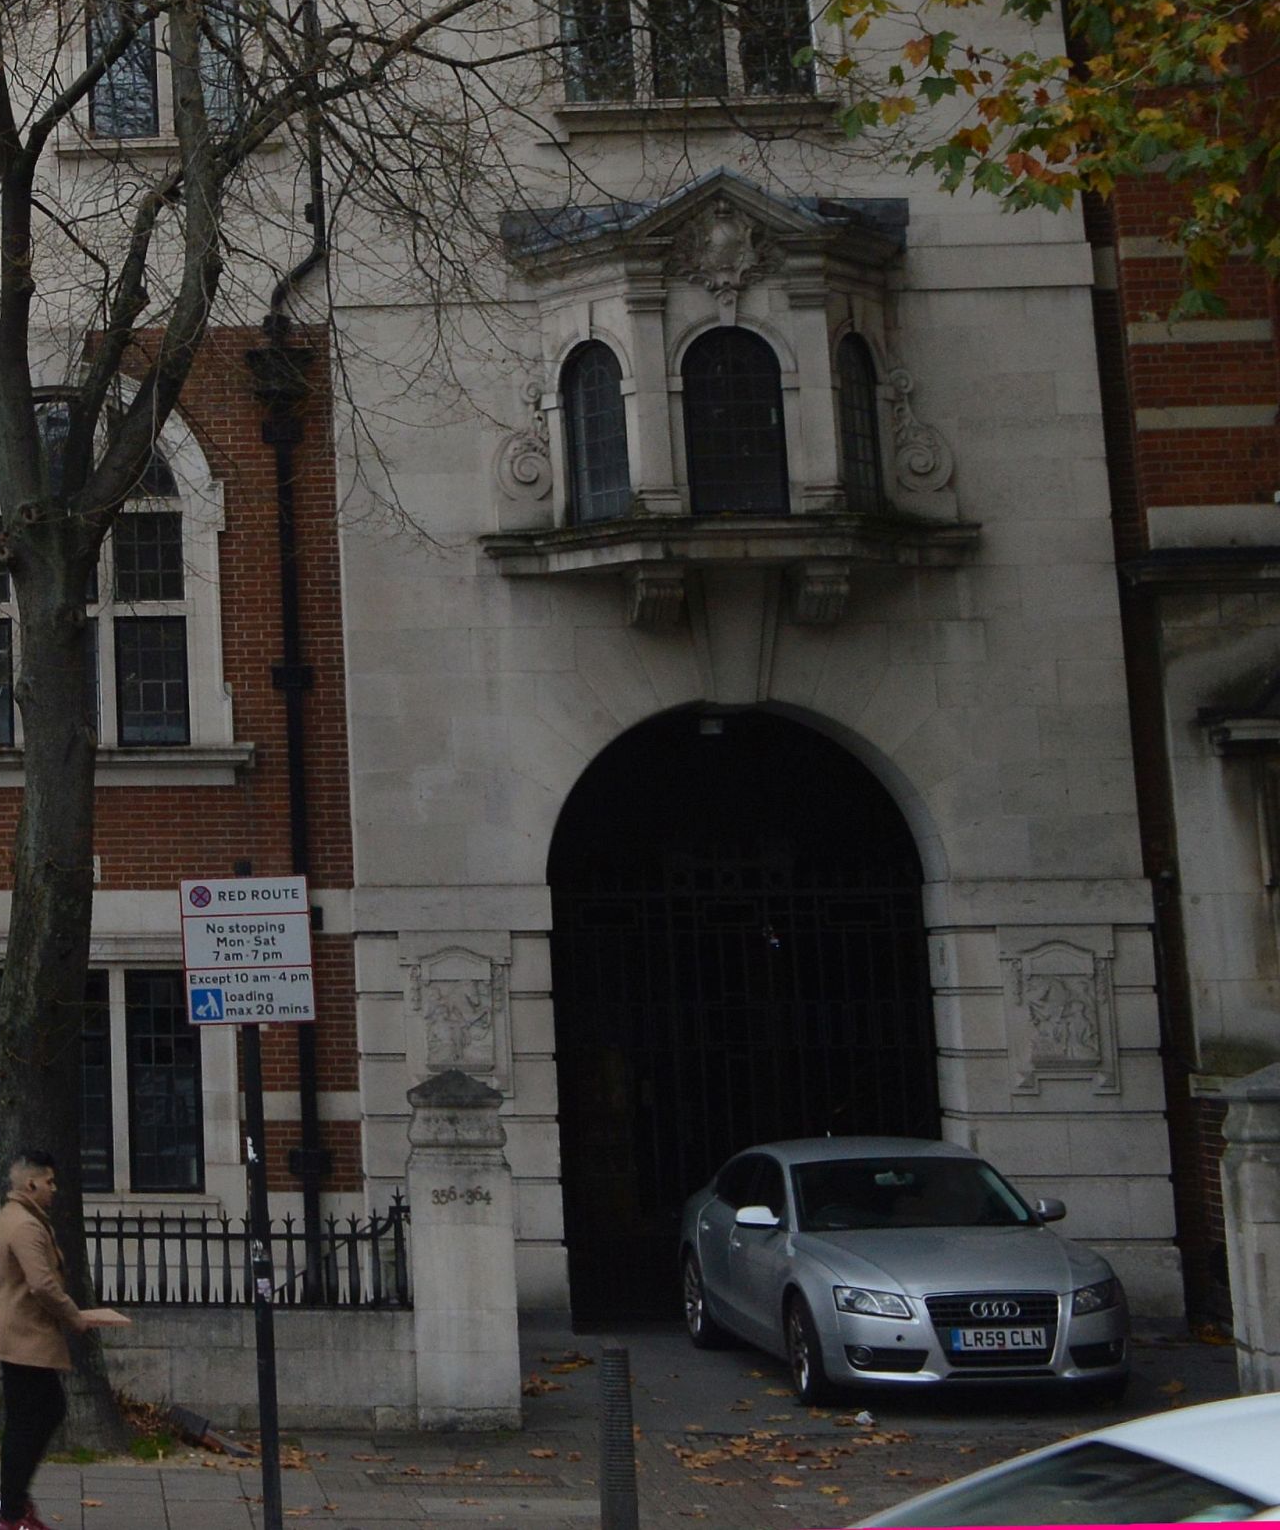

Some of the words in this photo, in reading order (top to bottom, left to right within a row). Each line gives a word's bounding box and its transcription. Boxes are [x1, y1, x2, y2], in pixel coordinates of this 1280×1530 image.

[218, 890, 246, 901] RED
[251, 888, 299, 900] ROUTE
[206, 923, 224, 934] No
[228, 921, 285, 935] stopping
[216, 937, 244, 947] Mon
[254, 935, 277, 946] Sat
[262, 950, 283, 962] pm
[190, 973, 231, 985] Except
[235, 973, 248, 983] 10
[291, 972, 310, 984] pm
[225, 990, 274, 1003] loading
[225, 1006, 252, 1016] max
[256, 1004, 274, 1015] 20
[278, 1003, 310, 1015] mins
[962, 1331, 1006, 1347] LR59
[1010, 1330, 1042, 1346] CLN
